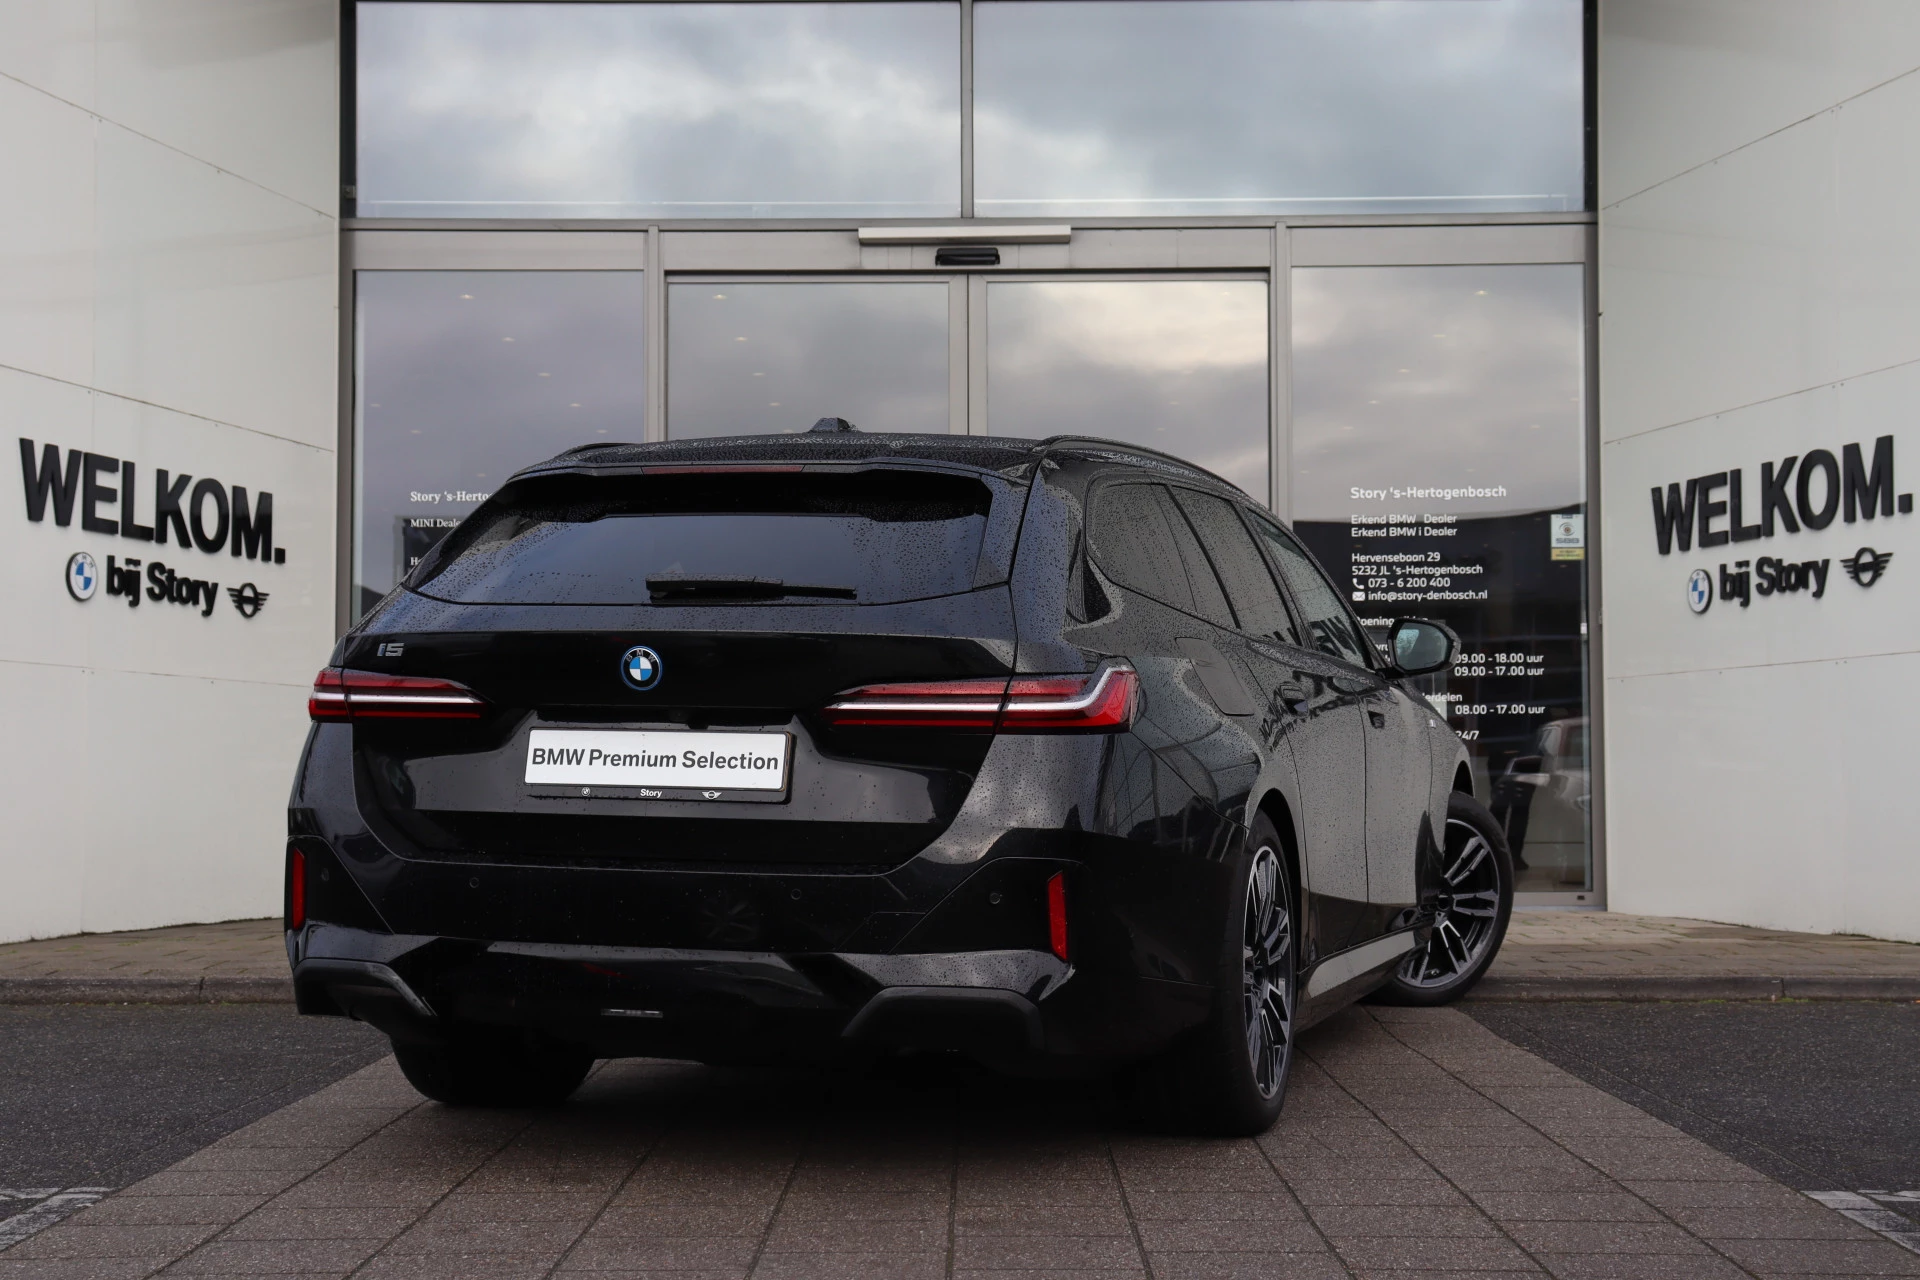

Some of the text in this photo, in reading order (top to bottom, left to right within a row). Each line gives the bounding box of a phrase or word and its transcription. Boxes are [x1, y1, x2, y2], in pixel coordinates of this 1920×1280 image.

[410, 491, 493, 504] Story 's-Herto
[1350, 485, 1507, 501] Story 's-Hertogenbosch
[1651, 434, 1913, 555] WELKOM.
[19, 437, 286, 564] WELKOM.
[410, 518, 461, 528] MINI Deale
[1351, 513, 1458, 525] Erkend BMW Dealer
[1351, 526, 1458, 537] Erkend BMW i Dealer
[1352, 552, 1440, 563] Hervensebaan 29
[1352, 564, 1483, 577] 5232 JL 's-Hertogenbosch
[106, 555, 218, 617] bij Story
[1368, 578, 1388, 588] 073
[1397, 577, 1404, 588] 6
[1406, 577, 1427, 588] 200
[1429, 577, 1451, 588] 400
[1719, 556, 1830, 608] bij Story
[1368, 589, 1488, 602] info@story-denbosch.nl
[376, 642, 405, 657] i5
[1494, 653, 1524, 663] 18.00
[1526, 654, 1544, 663] uur
[1454, 666, 1486, 676] 09.00
[1527, 667, 1544, 675] uur
[1455, 705, 1487, 715] 08.00
[1528, 705, 1546, 714] uur
[532, 748, 779, 770] BMW Premium Selection
[640, 788, 662, 798] Story
